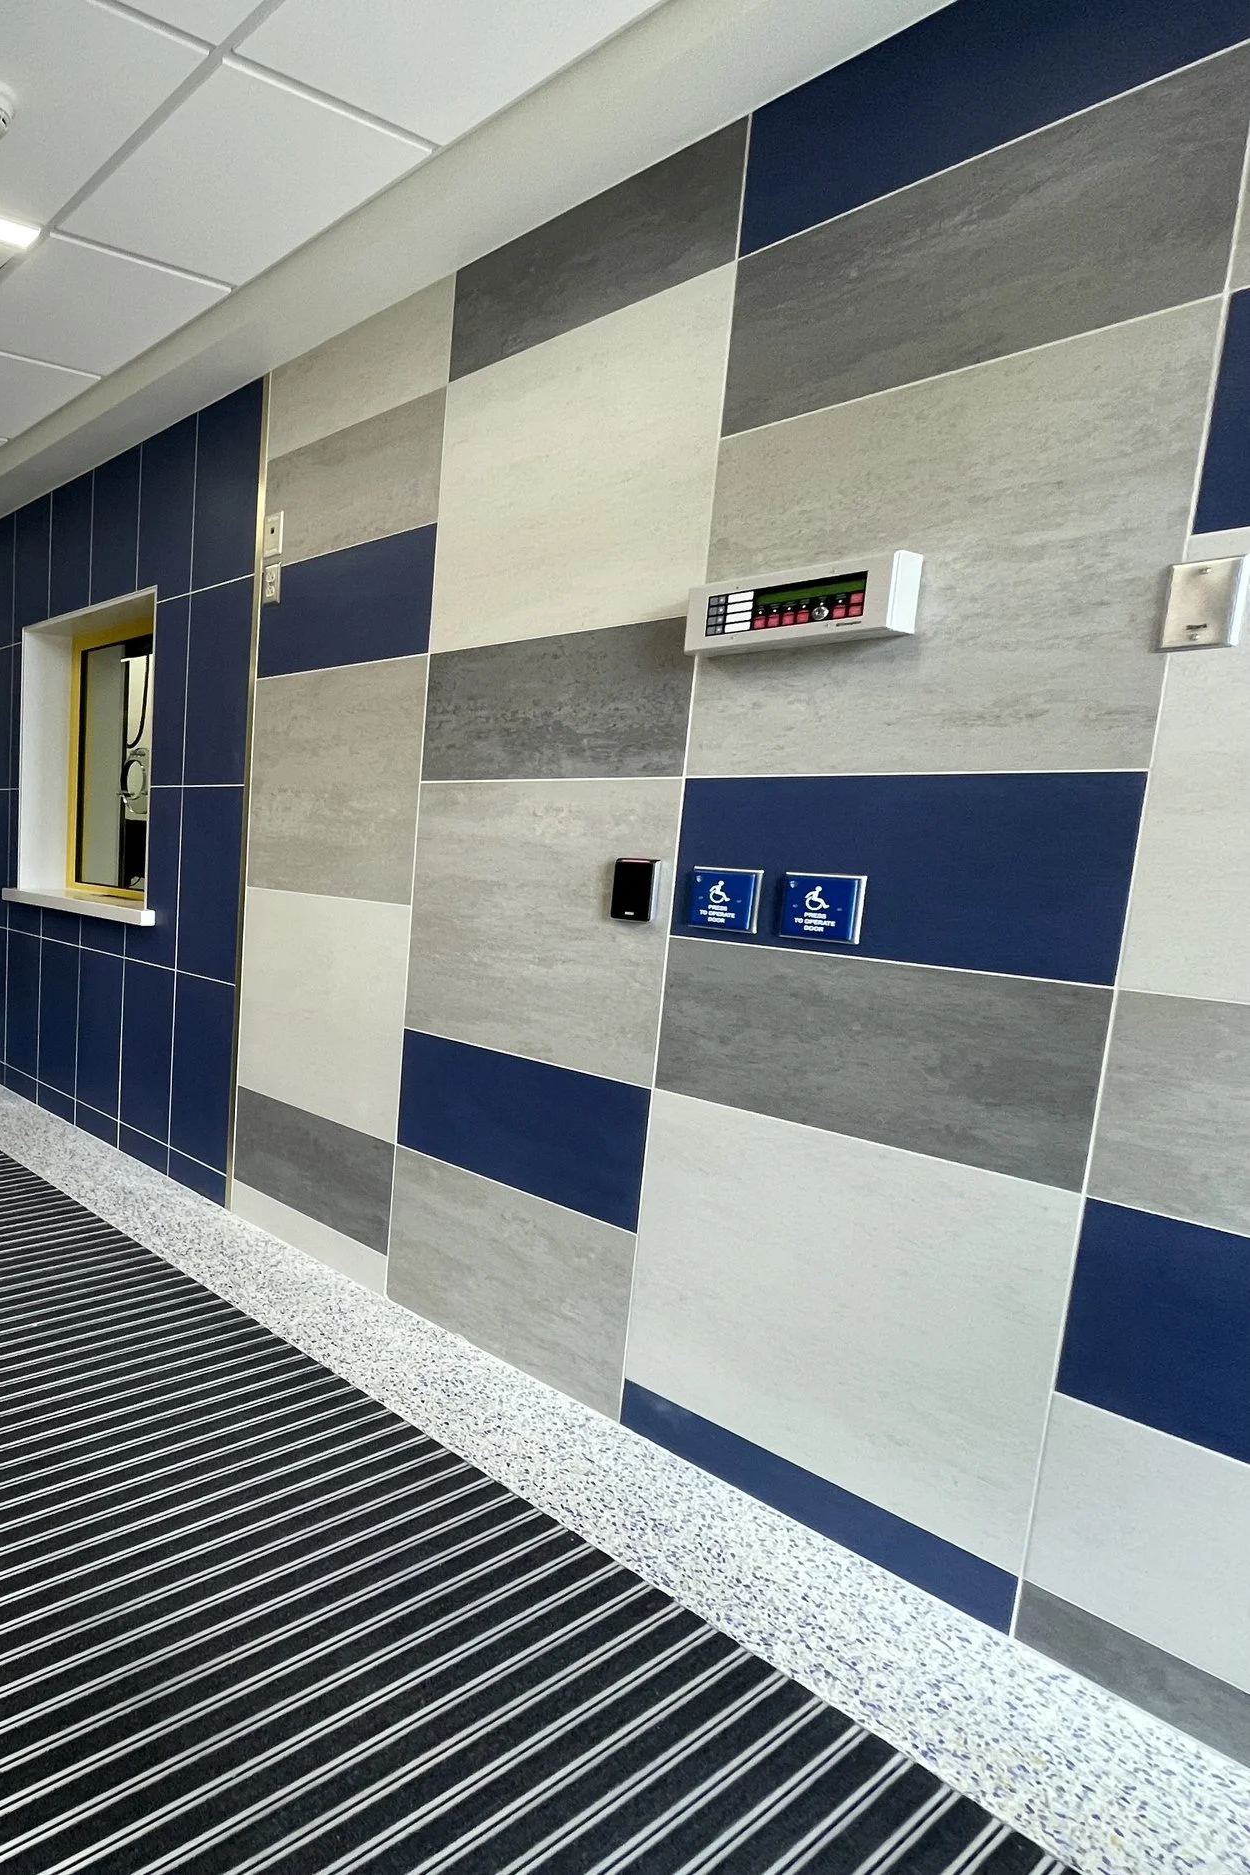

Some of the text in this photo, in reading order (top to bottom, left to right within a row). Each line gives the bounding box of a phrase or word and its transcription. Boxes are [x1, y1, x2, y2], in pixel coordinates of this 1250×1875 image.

[708, 910, 736, 919] OPERATE
[804, 918, 836, 927] OPERATE
[803, 924, 824, 932] DOOR
